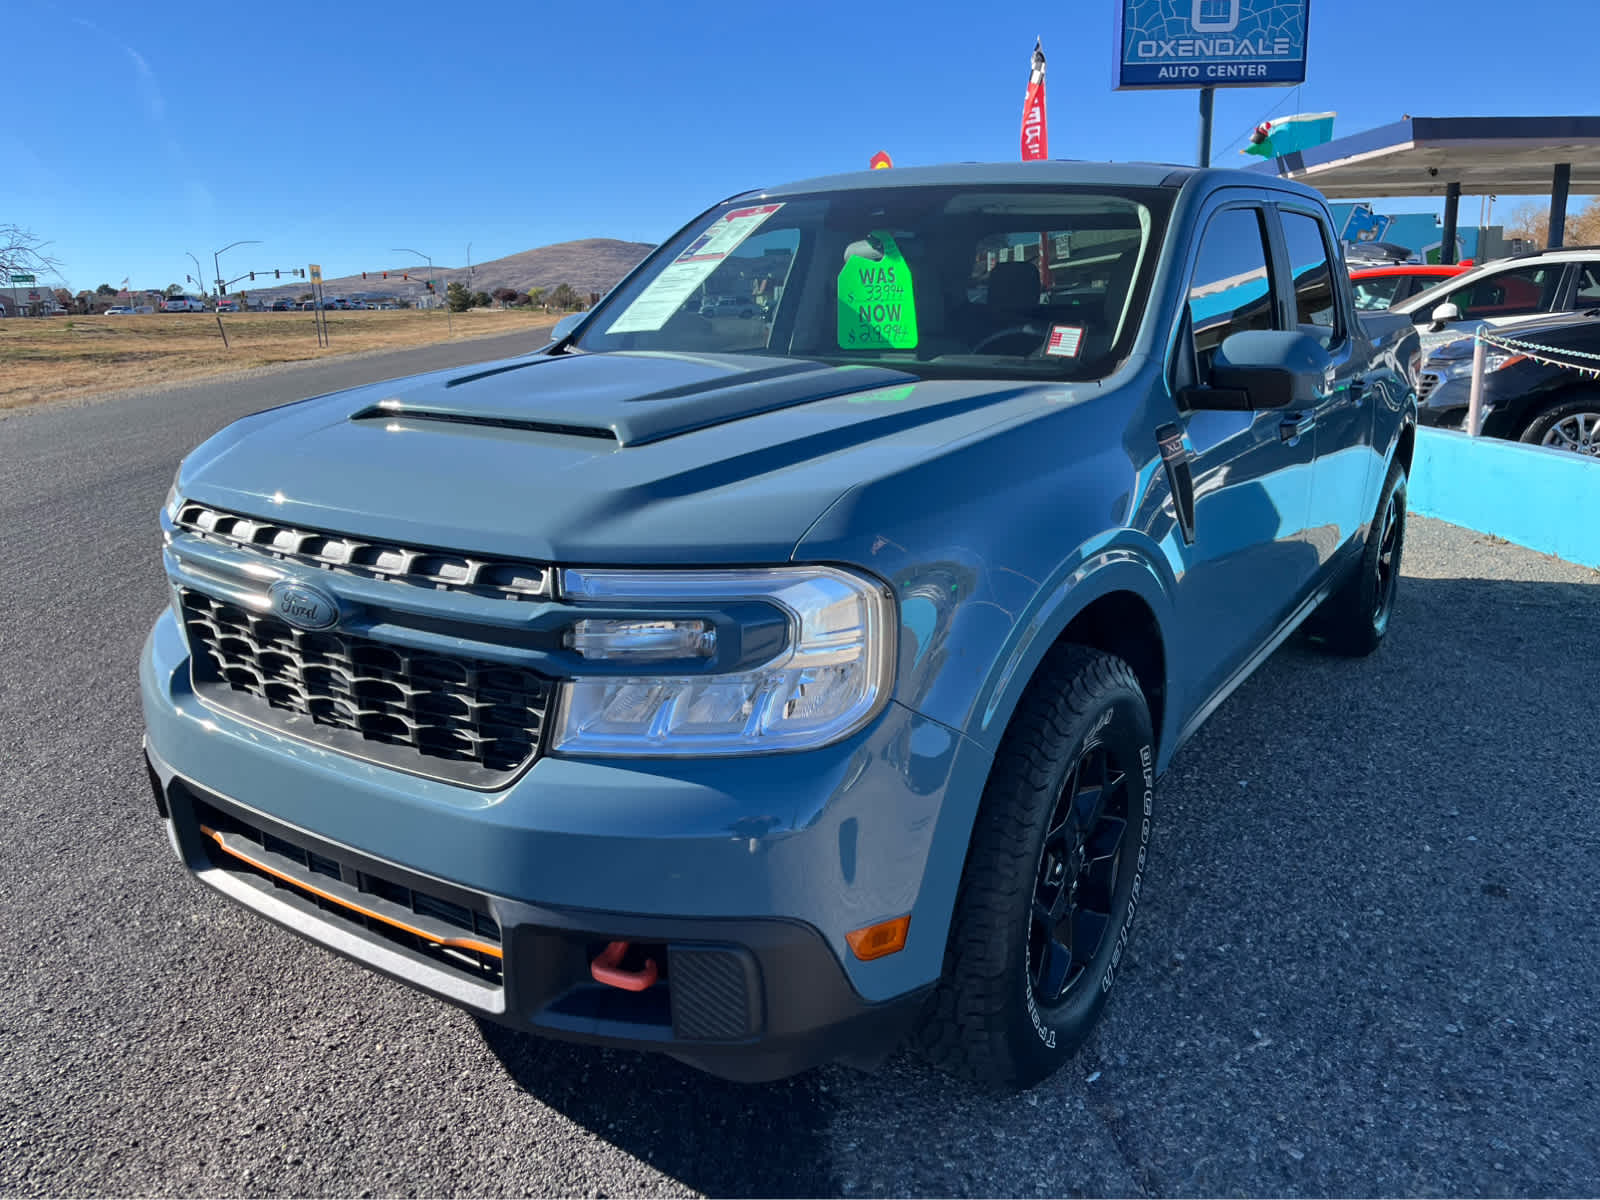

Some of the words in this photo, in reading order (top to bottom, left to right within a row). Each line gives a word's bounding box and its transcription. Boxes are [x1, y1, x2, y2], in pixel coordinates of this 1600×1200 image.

[1137, 38, 1290, 58] OXENDALE
[1158, 66, 1200, 78] AUTO
[1206, 65, 1267, 77] CENTER
[859, 267, 896, 284] WAS
[859, 304, 901, 322] NOW
[281, 591, 318, 619] Ford
